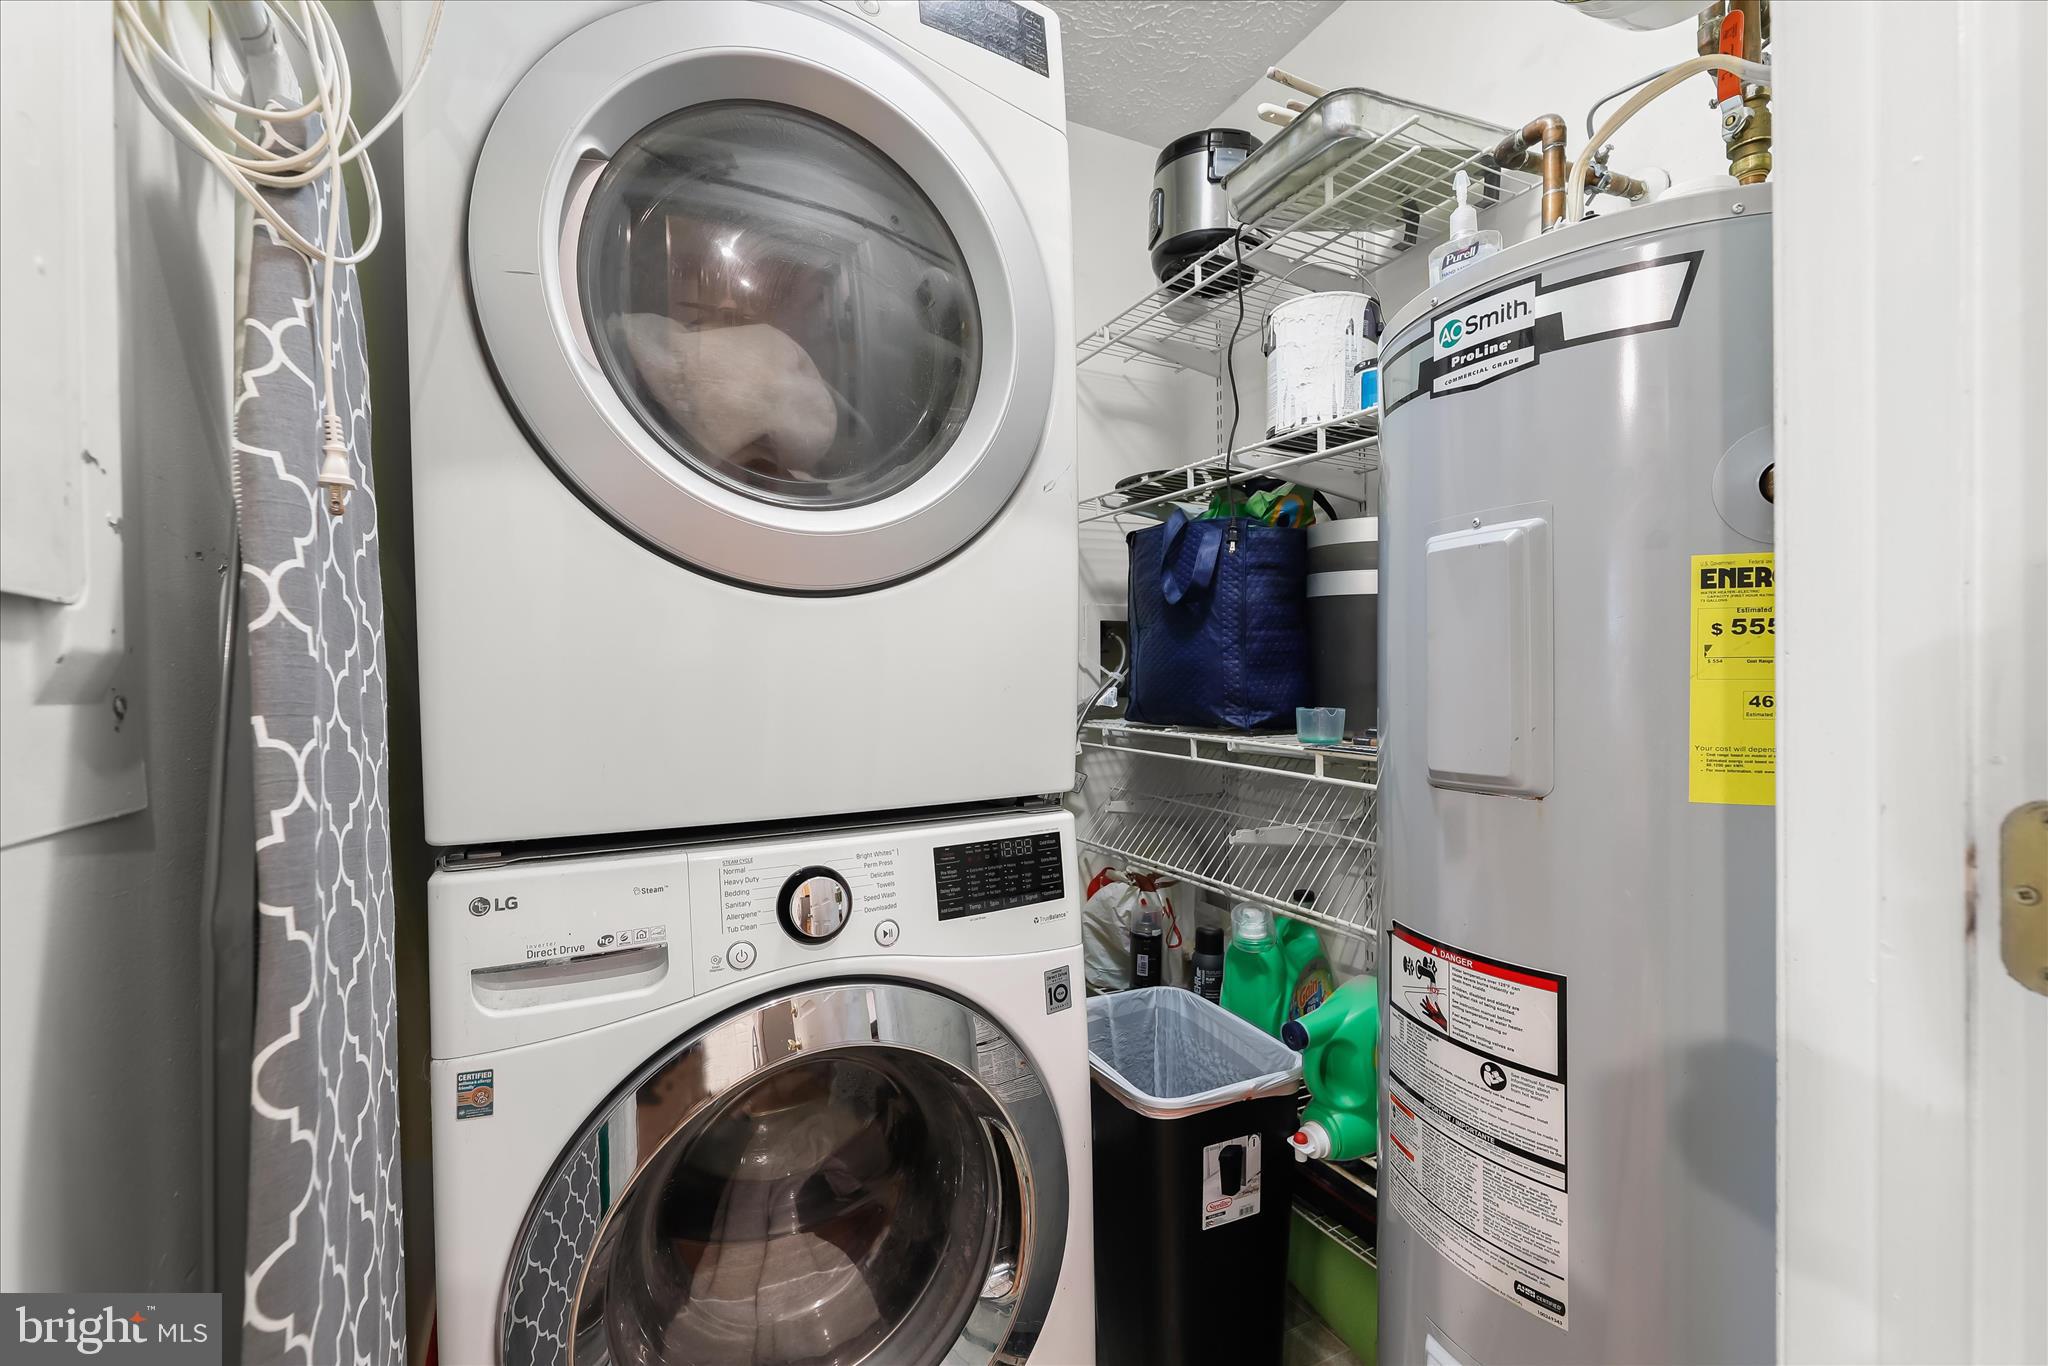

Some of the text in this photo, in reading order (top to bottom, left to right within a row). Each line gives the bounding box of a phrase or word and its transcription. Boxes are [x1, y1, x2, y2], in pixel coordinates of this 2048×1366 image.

[1446, 246, 1476, 265] Purell
[1451, 340, 1508, 367] ProLine
[1444, 356, 1519, 386] COMMERCIAL GRADE
[1711, 623, 1723, 636] $
[723, 867, 745, 875] Normal
[870, 871, 894, 879] Delicates
[495, 896, 518, 911] LG
[725, 901, 751, 909] Sanitary
[864, 903, 897, 913] Downloaded
[526, 941, 557, 949] Inverter
[526, 944, 585, 959] Direct Drive
[1440, 950, 1473, 968] DANGER
[1048, 983, 1068, 1005] 10
[459, 1072, 492, 1081] CERTIFIED
[1521, 1076, 1537, 1085] manual
[1424, 1099, 1451, 1121] IMPORTANT
[1455, 1119, 1495, 1144] IMPORTANTE
